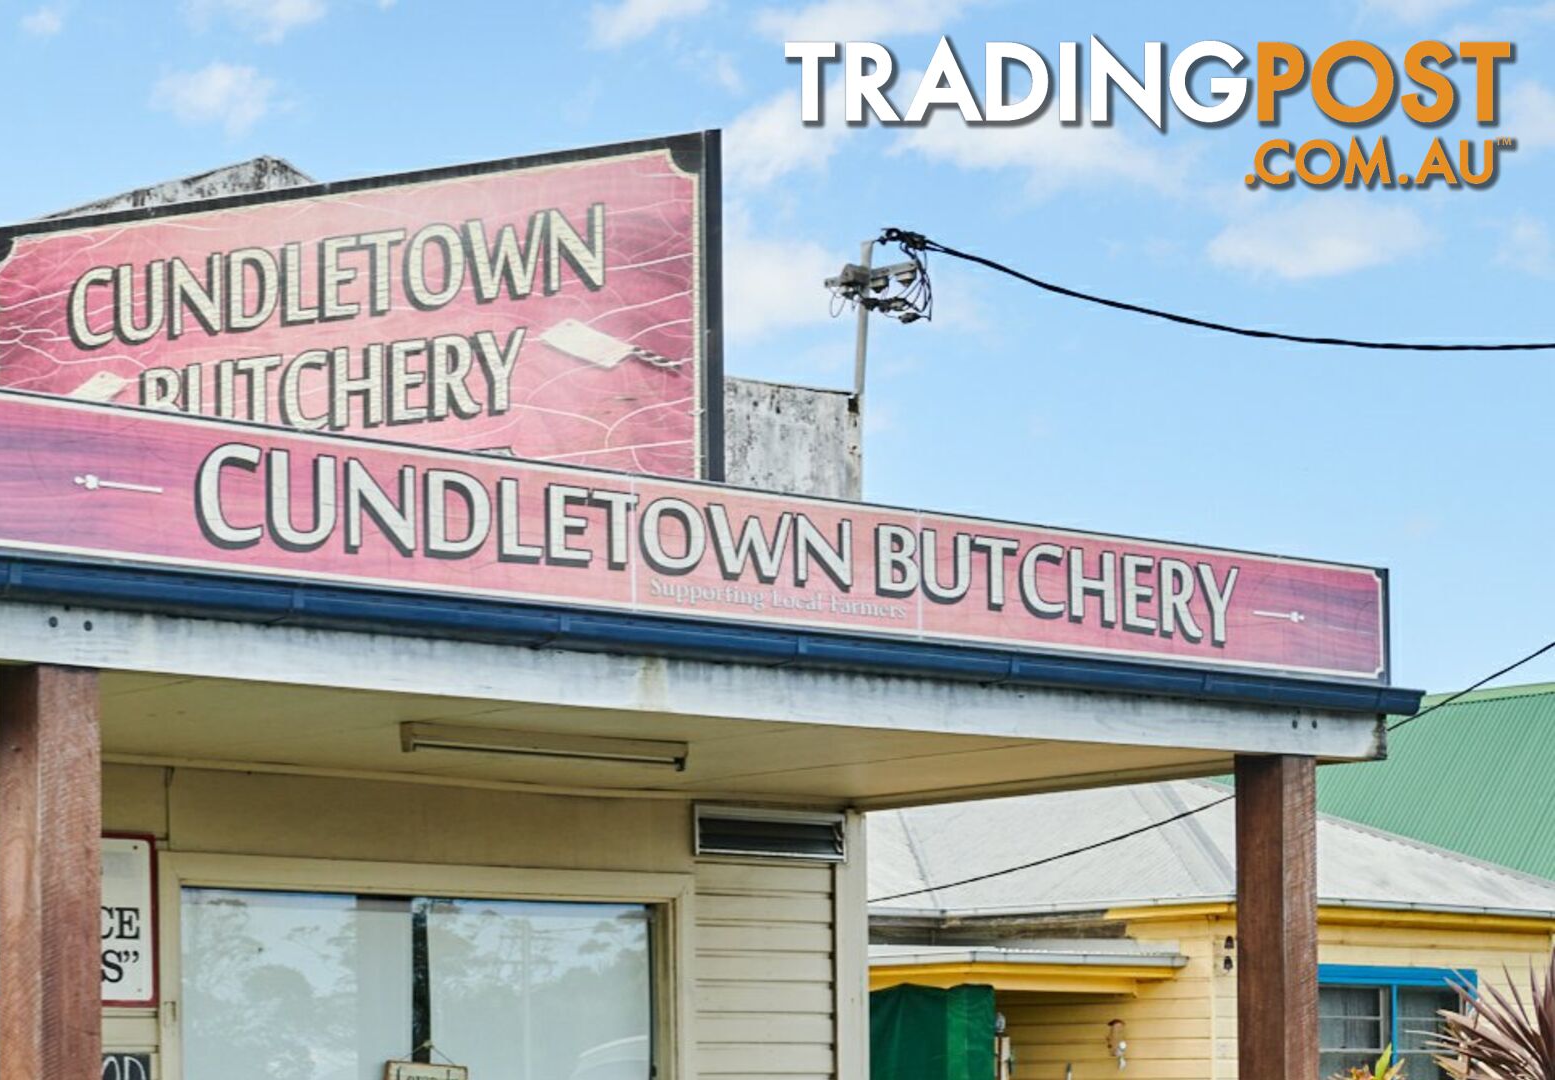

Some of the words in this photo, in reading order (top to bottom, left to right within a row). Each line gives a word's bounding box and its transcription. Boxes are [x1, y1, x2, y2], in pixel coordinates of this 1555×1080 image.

[67, 202, 606, 350] CUNDLETOWN
[195, 442, 852, 592] CUNDLETOWN
[876, 523, 1238, 646] BUTCHERY
[651, 577, 765, 611] Supporting
[772, 588, 823, 612] Local
[831, 596, 907, 619] Farmers
